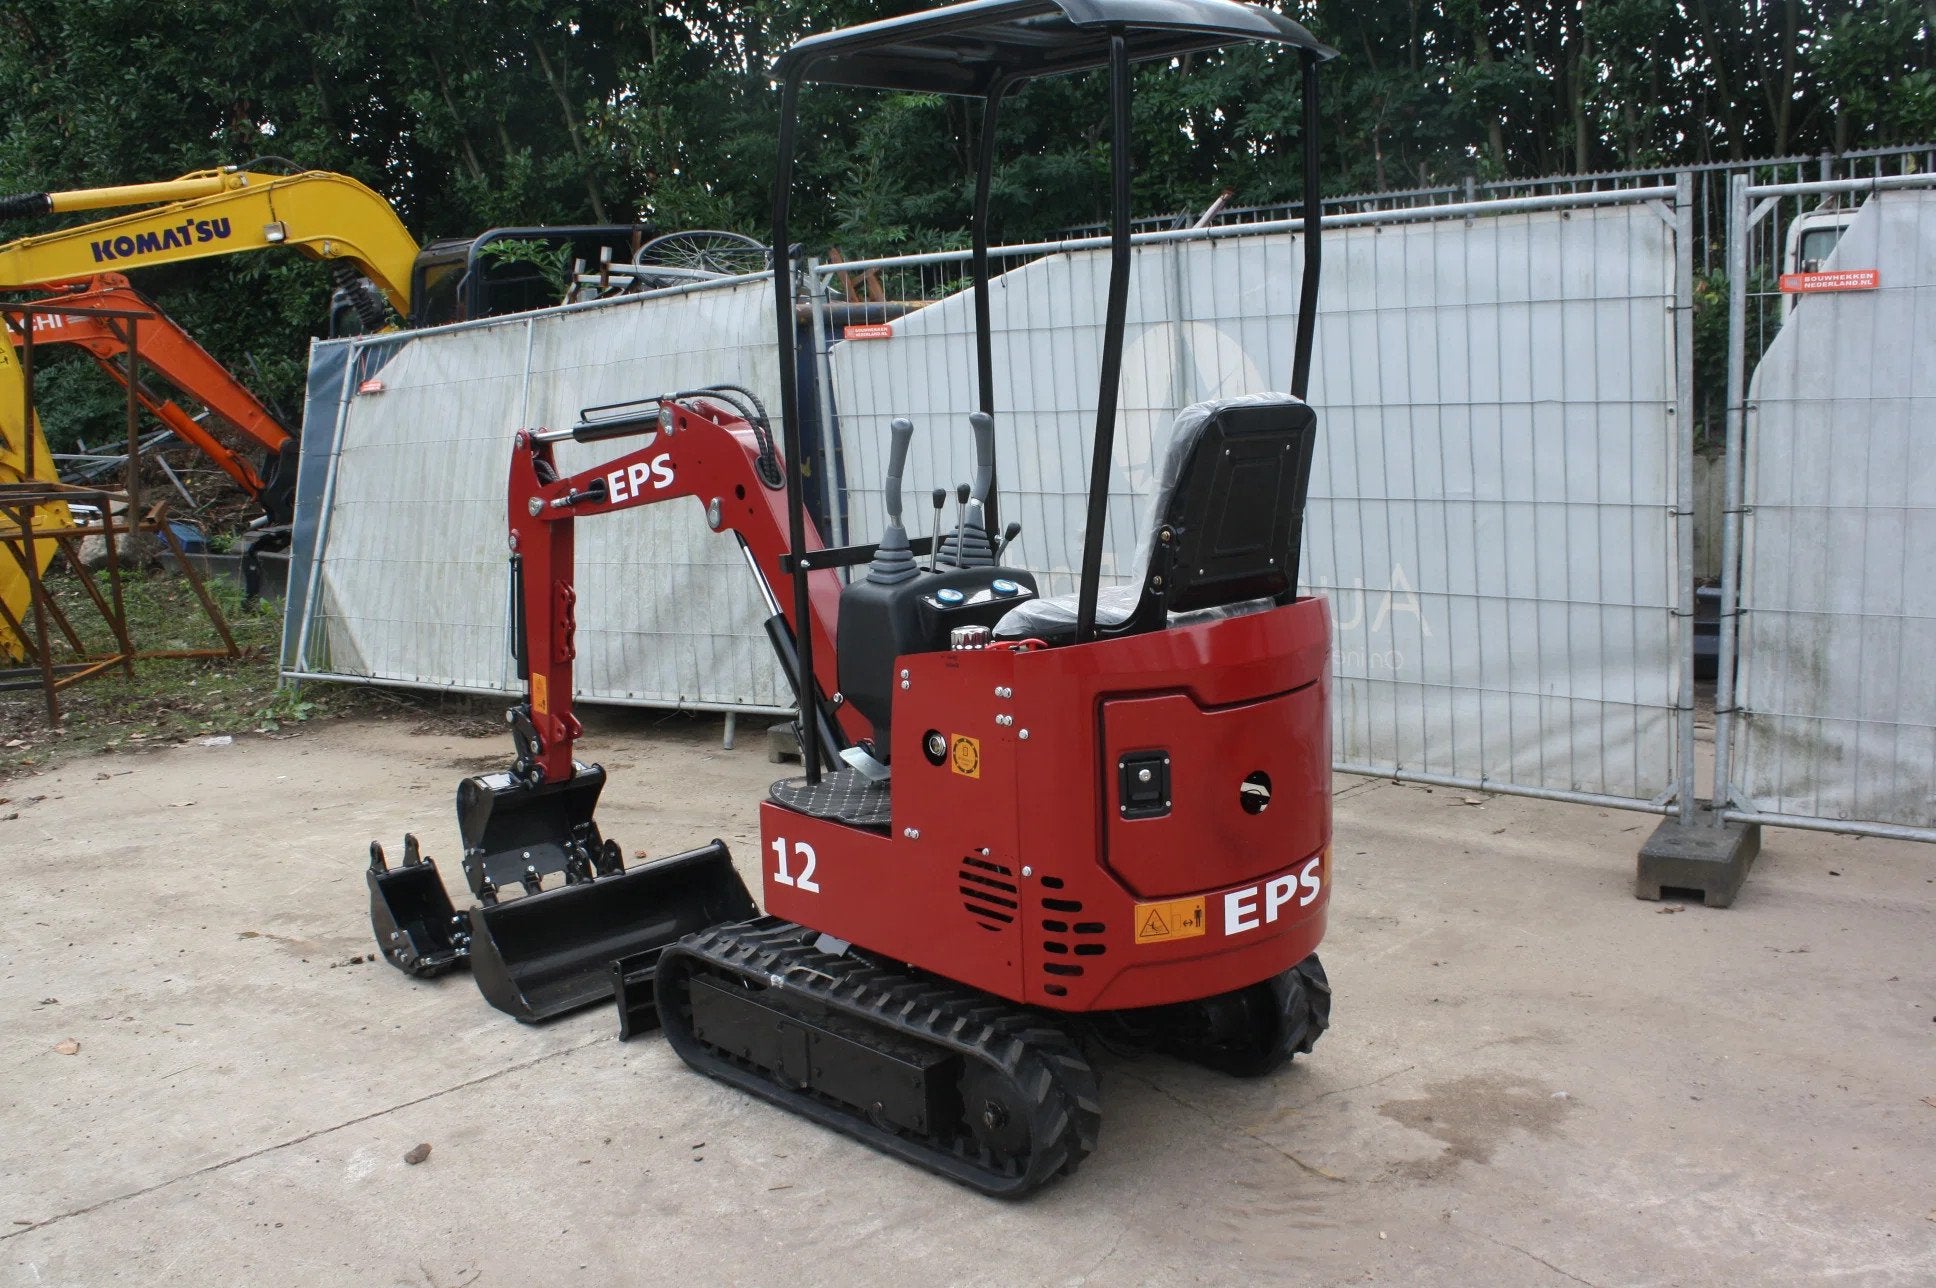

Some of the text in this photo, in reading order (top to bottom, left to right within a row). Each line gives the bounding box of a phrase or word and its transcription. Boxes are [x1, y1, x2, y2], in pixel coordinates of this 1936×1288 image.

[91, 217, 232, 263] KOMATSU
[1804, 273, 1874, 282] BOUWHEKKEN
[1804, 279, 1873, 289] NEDERLAND.NL
[607, 453, 675, 504] EPS
[772, 836, 820, 894] 12
[1224, 857, 1320, 936] EPS
